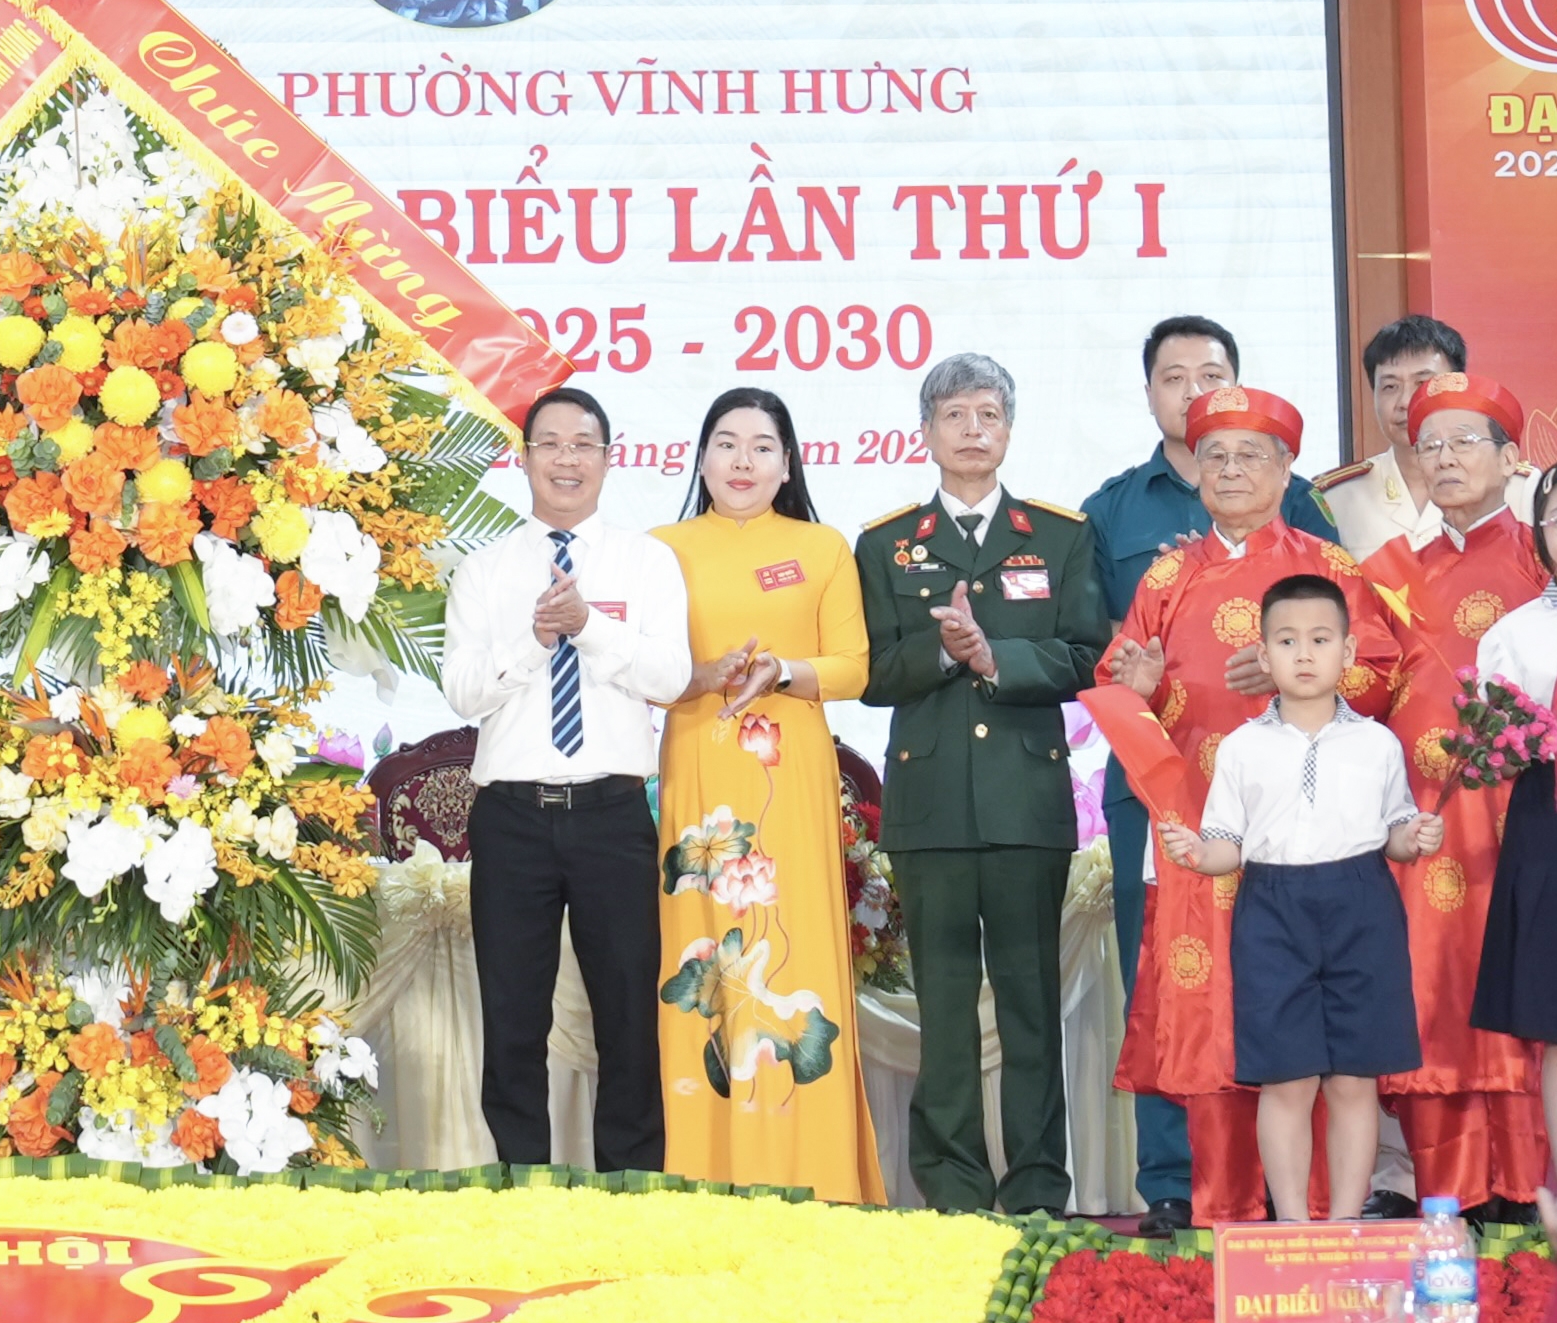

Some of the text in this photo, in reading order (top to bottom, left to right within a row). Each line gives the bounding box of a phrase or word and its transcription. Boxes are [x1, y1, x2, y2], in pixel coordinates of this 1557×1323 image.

[283, 51, 978, 118] PHƯỜNG VĨNH HƯNG
[138, 30, 464, 333] Chúc Mừng
[396, 140, 1170, 266] BIỂU LẦN THỨ I
[512, 303, 934, 373] 25 - 2030
[608, 432, 692, 476] áng
[853, 430, 929, 465] 202
[1234, 1293, 1273, 1323] ĐẠI
[1275, 1283, 1324, 1317] BIỂU
